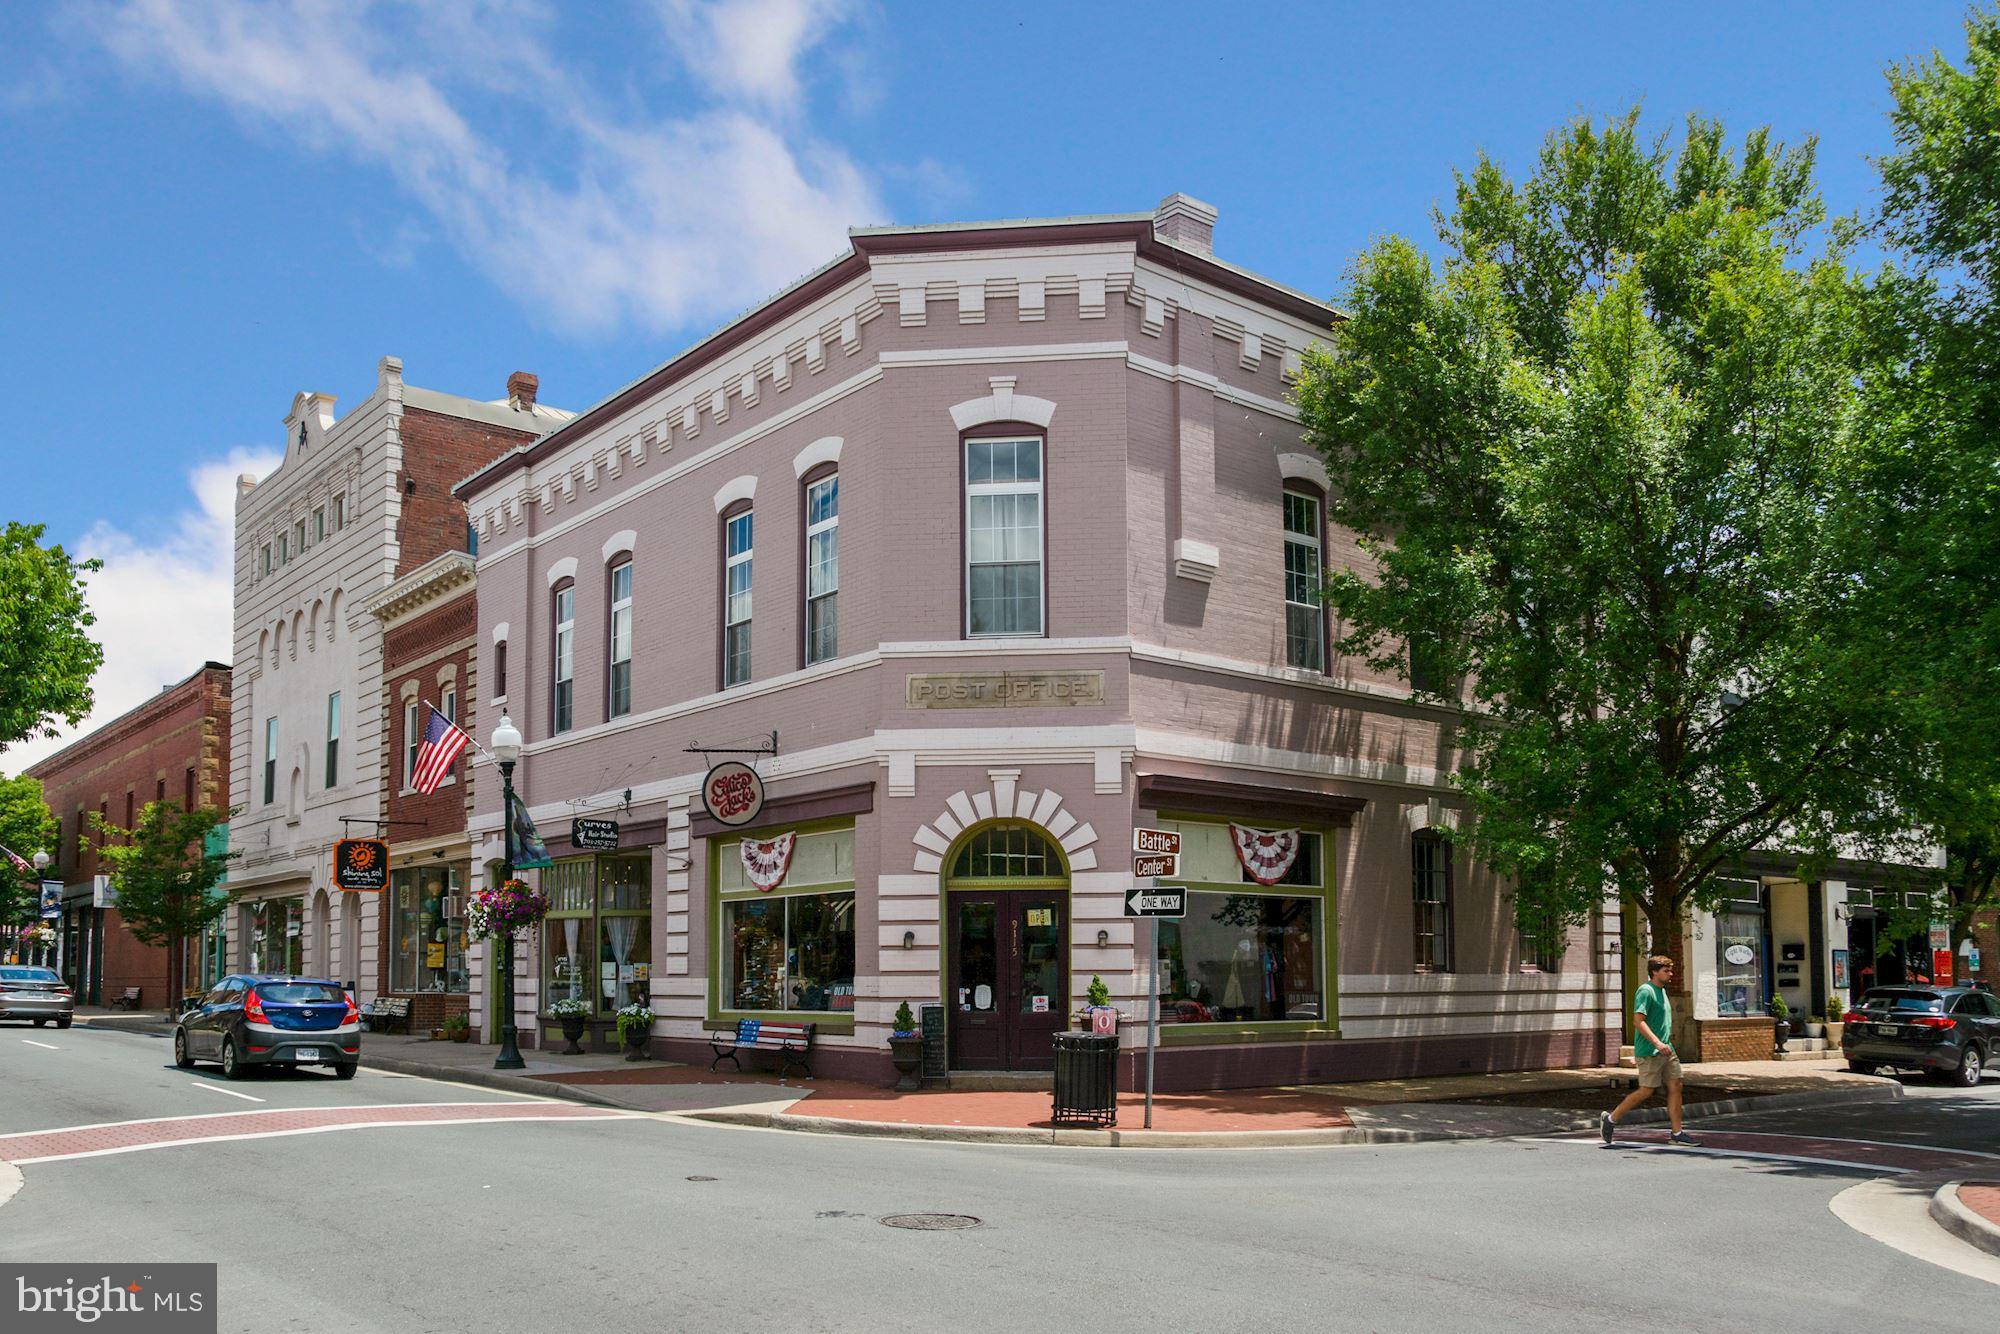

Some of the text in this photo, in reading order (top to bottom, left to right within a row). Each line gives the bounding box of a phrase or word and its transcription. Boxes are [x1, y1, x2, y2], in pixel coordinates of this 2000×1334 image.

[917, 682, 986, 700] POST
[588, 829, 618, 839] Hair Studio
[1140, 832, 1171, 851] Battle
[342, 866, 382, 879] shining sol
[1136, 857, 1173, 876] Center St
[1141, 896, 1179, 908] ONE WAY
[834, 986, 845, 996] OLD
